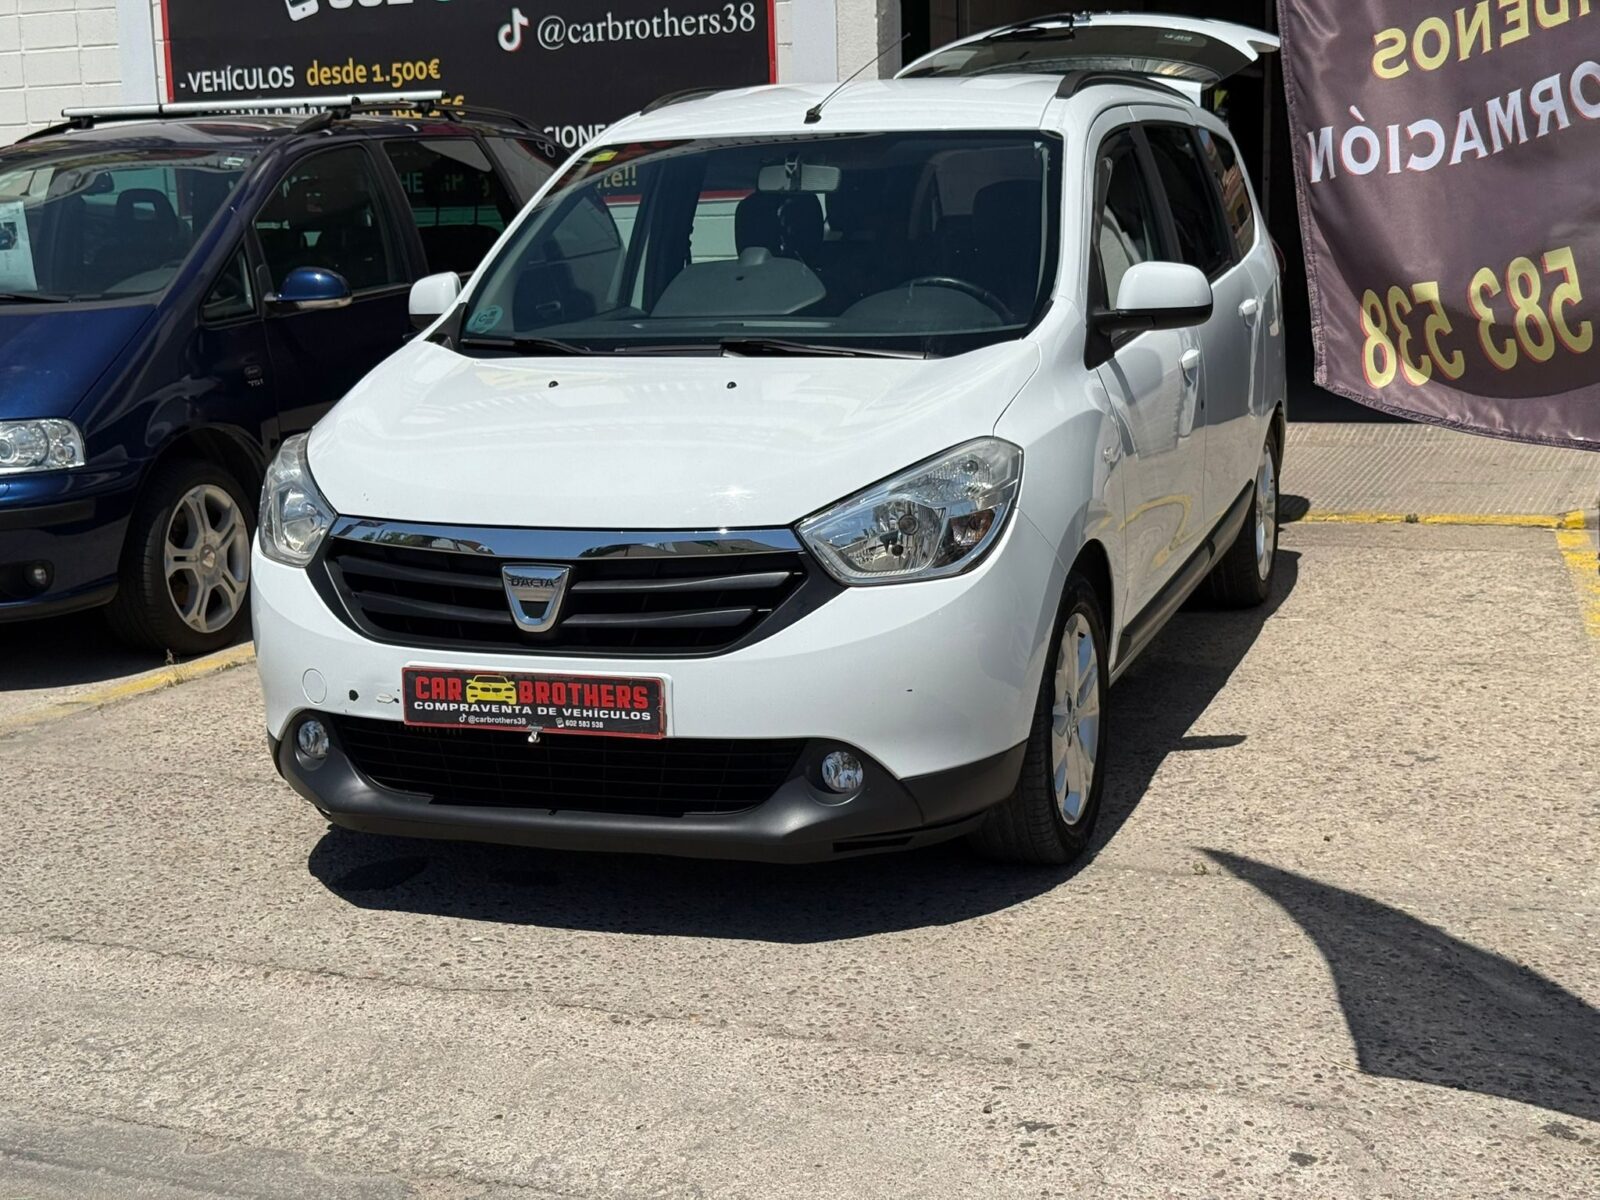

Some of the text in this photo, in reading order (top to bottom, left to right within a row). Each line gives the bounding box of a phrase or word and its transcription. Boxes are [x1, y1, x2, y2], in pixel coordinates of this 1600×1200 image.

[537, 2, 756, 50] @carbrothers38
[306, 58, 367, 87] desde
[372, 58, 441, 88] 1.500€
[510, 576, 555, 588] DACIA
[415, 675, 649, 710] CAR BROTHERS
[414, 701, 651, 721] COMPRAVENTA DE VEHÍCULOS
[467, 716, 527, 725] @carbrothers38
